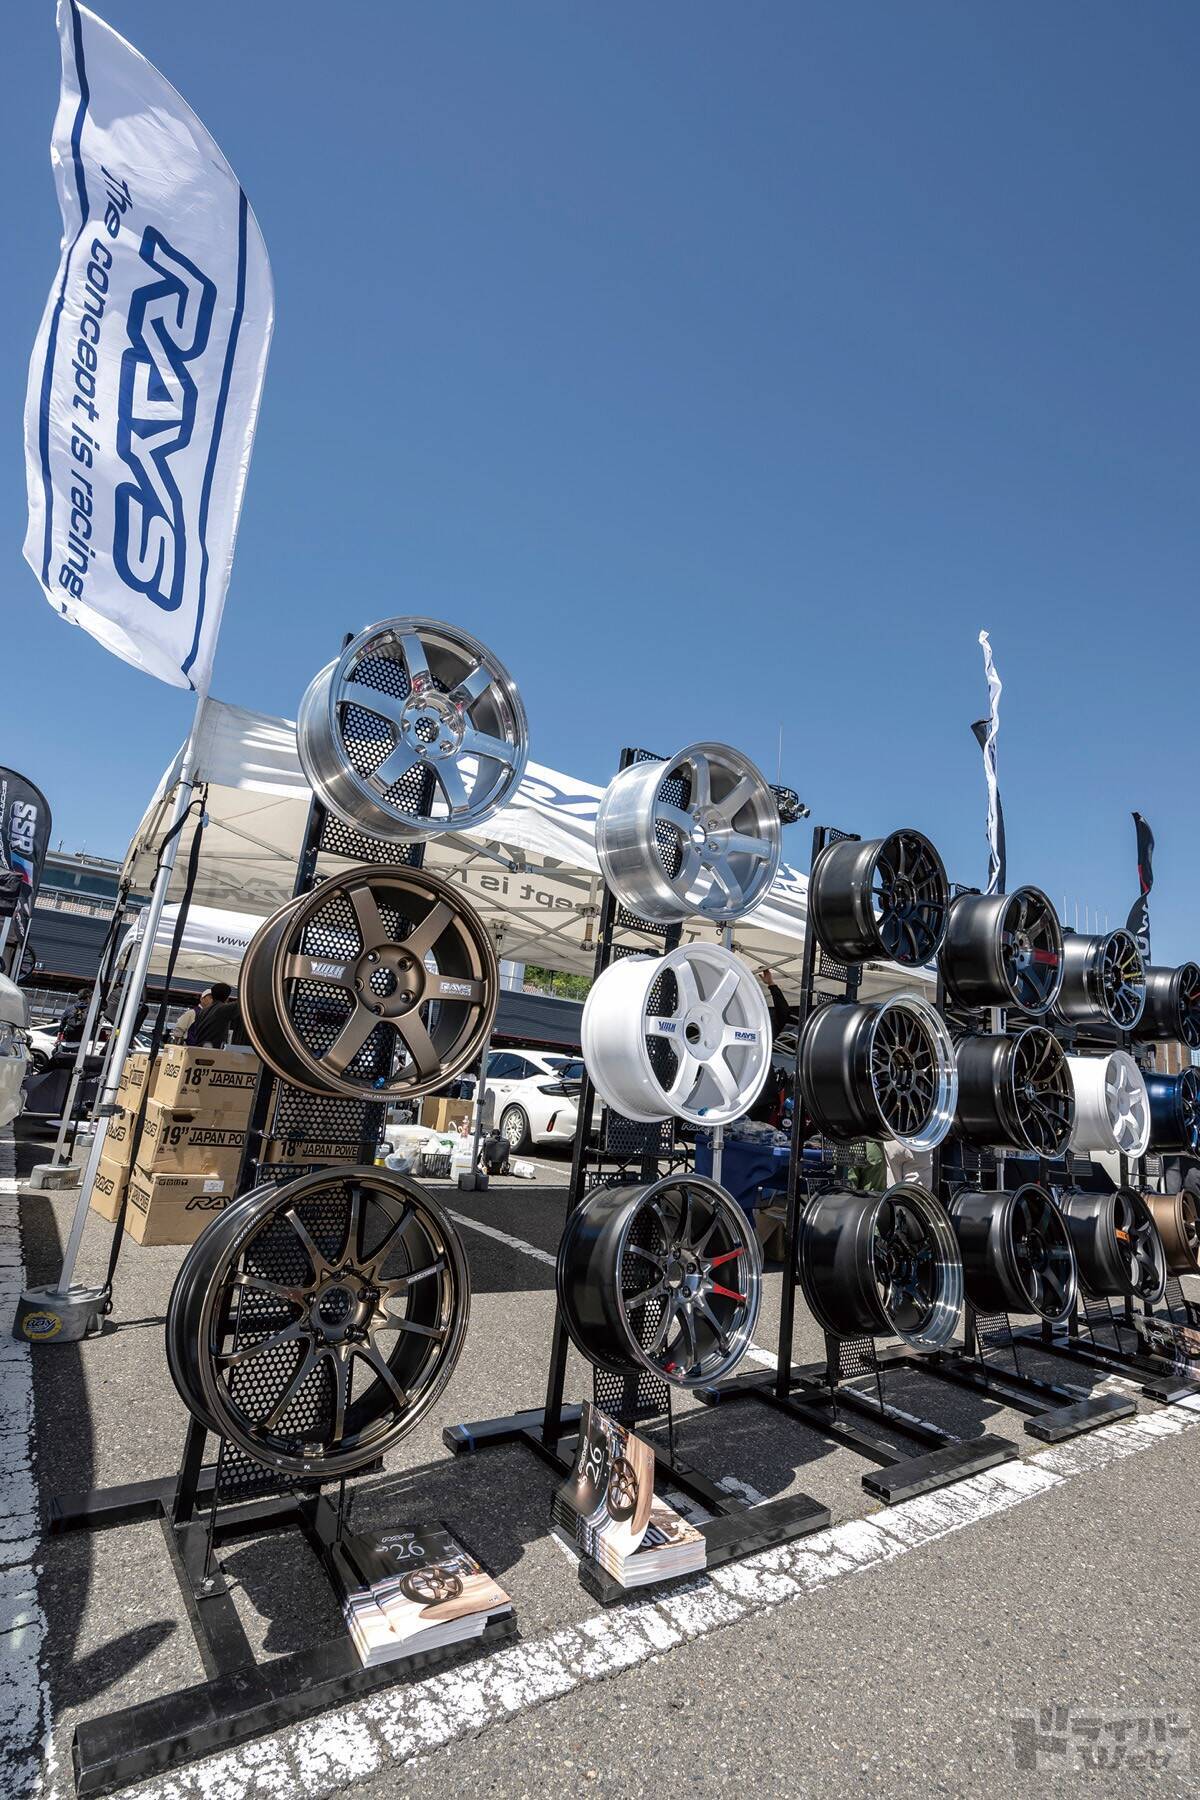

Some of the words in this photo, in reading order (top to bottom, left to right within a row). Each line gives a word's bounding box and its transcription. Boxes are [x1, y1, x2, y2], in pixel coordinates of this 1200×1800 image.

[72, 239, 113, 421] concept
[114, 224, 218, 612] RAYS
[72, 422, 101, 468] is
[9, 800, 38, 855] SSR
[734, 1031, 757, 1040] RAYS
[209, 1072, 243, 1086] JAPAN
[189, 1131, 224, 1143] JAPAN
[303, 1143, 333, 1155] JAPAN
